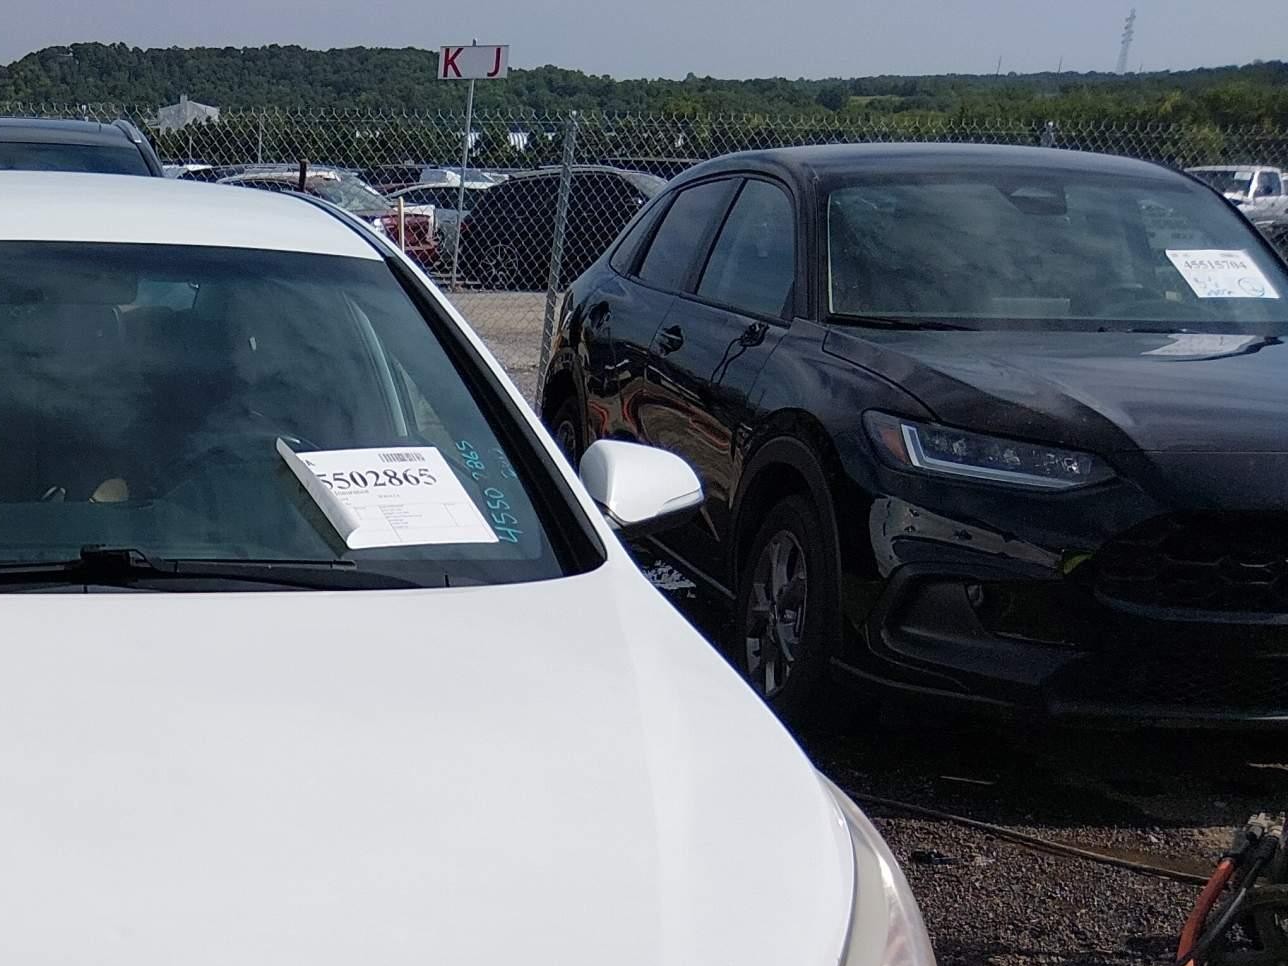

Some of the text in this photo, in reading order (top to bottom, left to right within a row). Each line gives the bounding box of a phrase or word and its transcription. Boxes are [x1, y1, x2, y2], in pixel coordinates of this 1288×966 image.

[443, 47, 501, 78] K J
[484, 487, 524, 543] 4550
